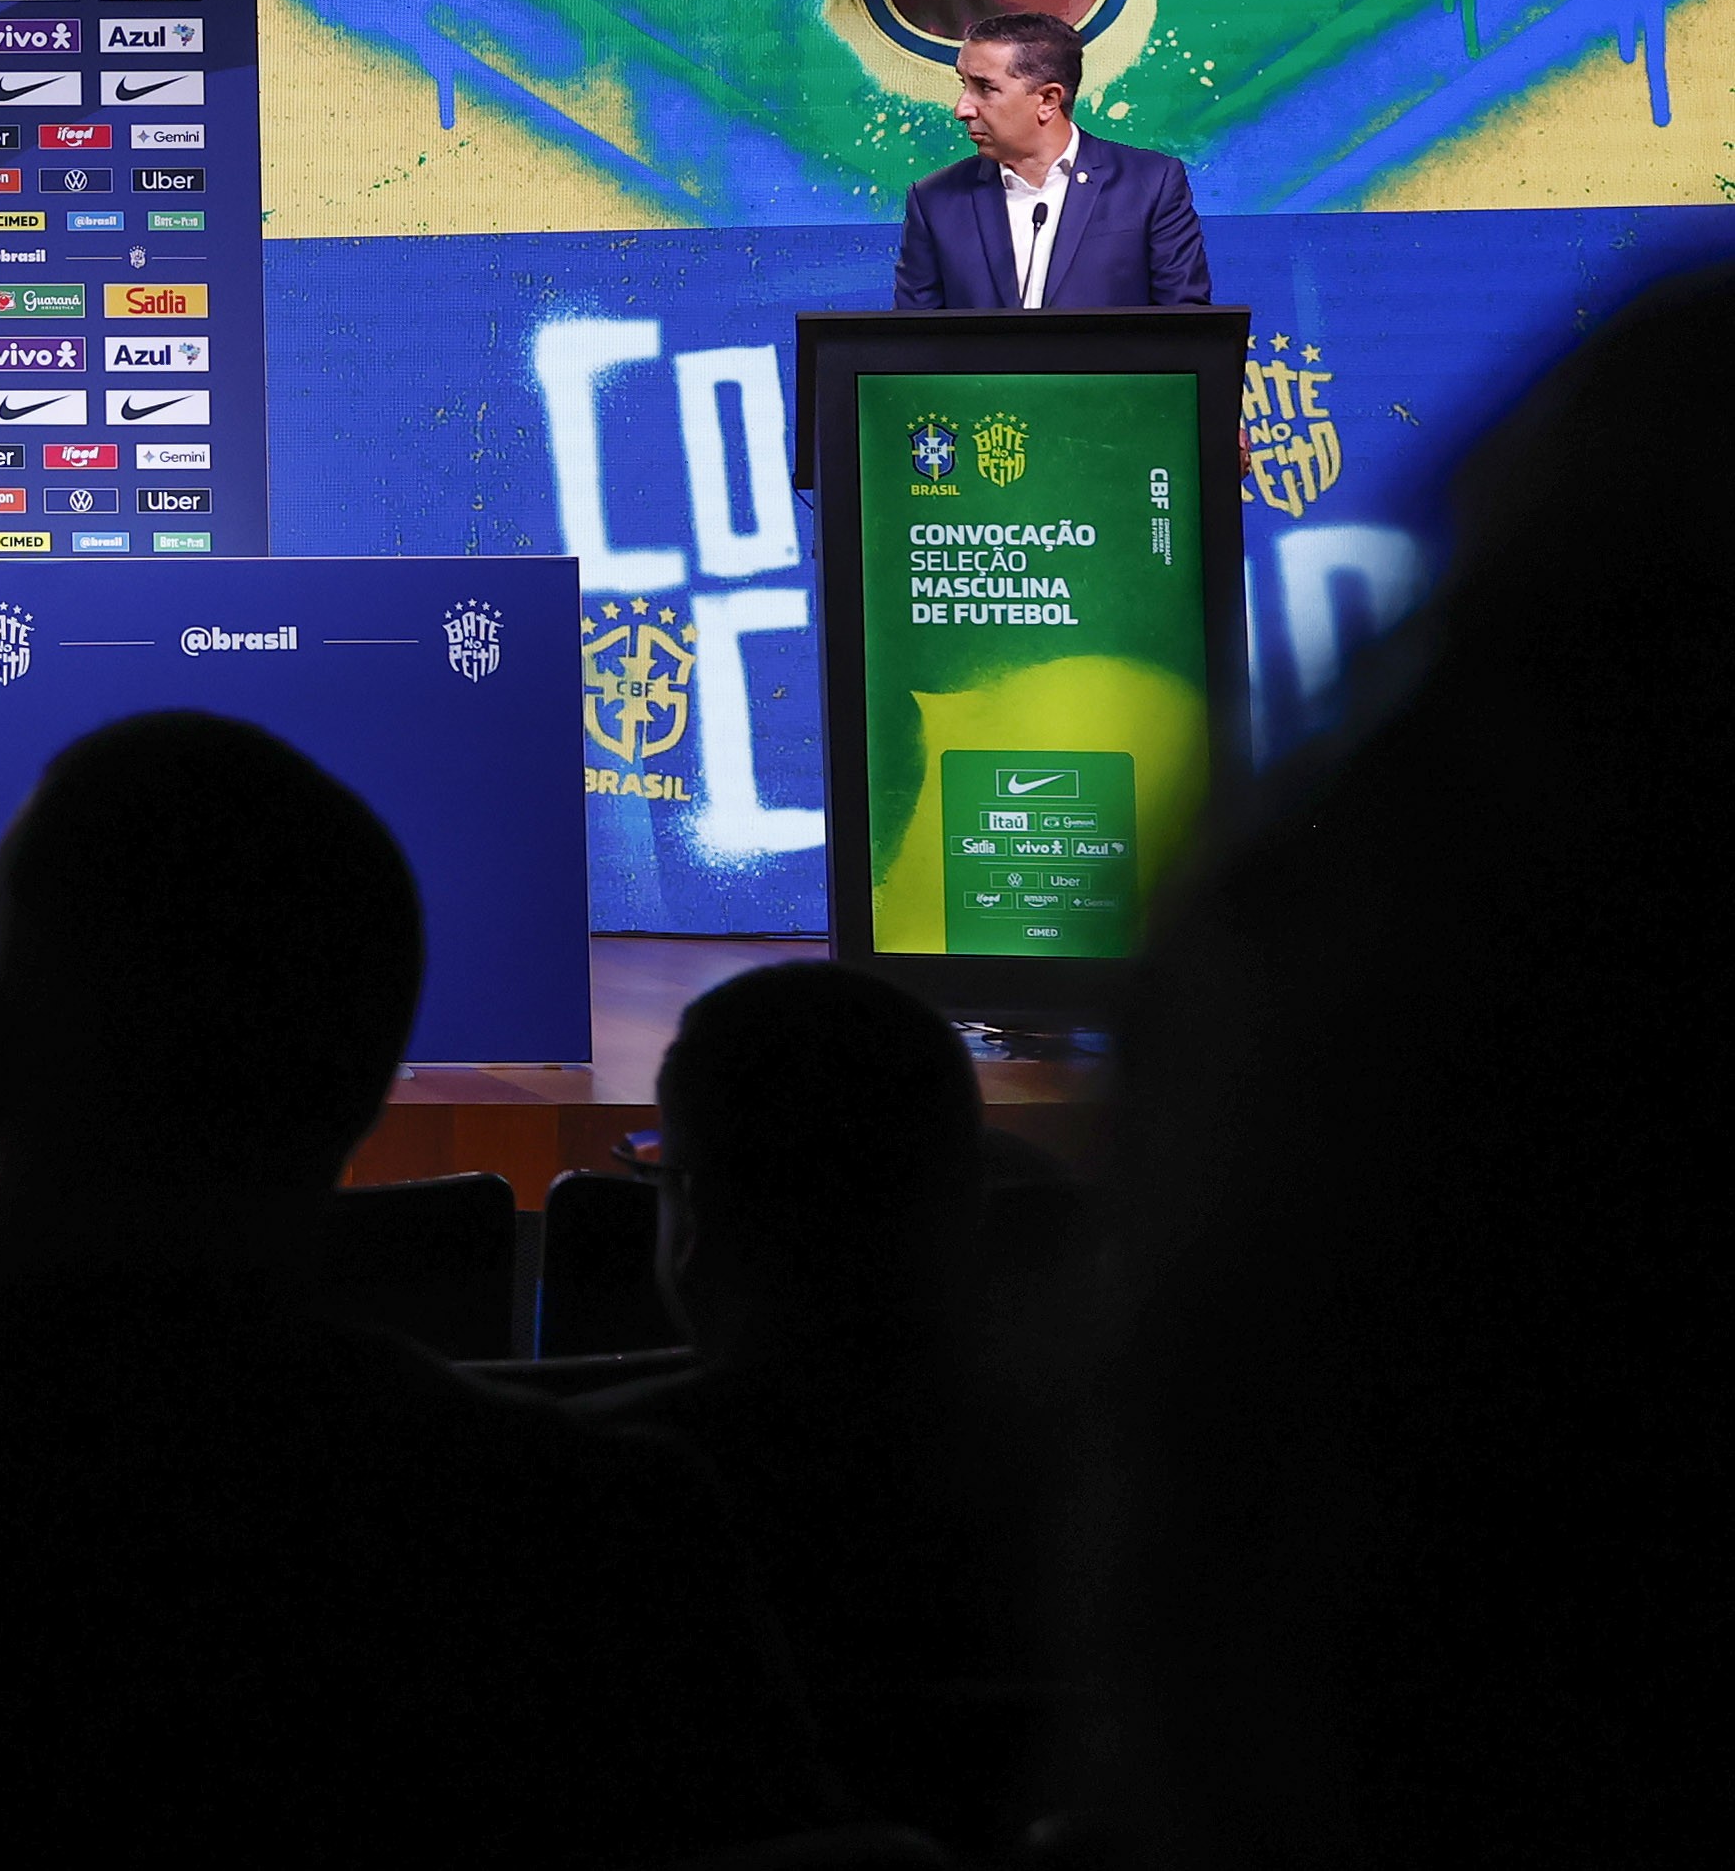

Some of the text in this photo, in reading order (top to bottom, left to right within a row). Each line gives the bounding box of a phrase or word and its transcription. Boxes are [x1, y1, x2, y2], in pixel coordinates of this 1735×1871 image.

[154, 131, 199, 142] Gemini
[1242, 360, 1333, 420] ATE
[972, 423, 1029, 452] BATE
[1249, 419, 1292, 444] NO
[992, 447, 1009, 458] NO
[1241, 421, 1342, 518] EITO
[912, 485, 960, 495] BRASIL
[1151, 469, 1168, 509] CBF
[910, 520, 1095, 553] CONVOCAÇÃO
[910, 547, 1027, 576] SELEÇÃO
[911, 577, 1070, 598] MASCULINA
[913, 604, 1078, 624] DE FUTEBOL
[444, 611, 505, 644] BATE
[181, 627, 297, 656] @brasil
[464, 638, 483, 649] NO
[585, 767, 692, 801] BRASIL
[992, 815, 1023, 829] itaú
[962, 838, 996, 854] Sadia
[1016, 841, 1049, 853] vivo
[1077, 842, 1108, 855] Azul
[1050, 875, 1080, 887] Uber
[1024, 895, 1058, 904] amazon
[1027, 928, 1058, 937] CIMED
